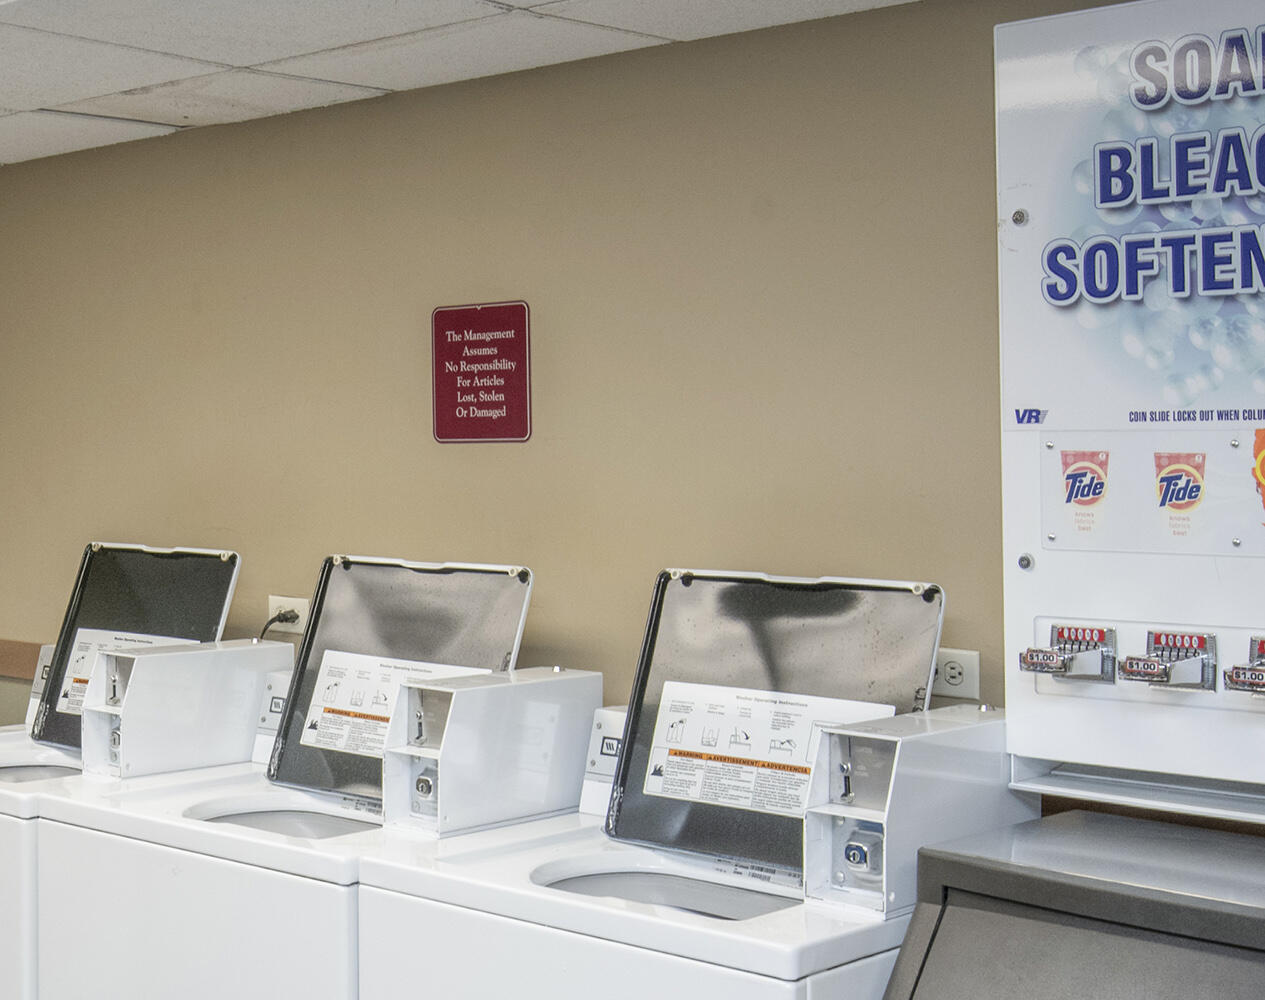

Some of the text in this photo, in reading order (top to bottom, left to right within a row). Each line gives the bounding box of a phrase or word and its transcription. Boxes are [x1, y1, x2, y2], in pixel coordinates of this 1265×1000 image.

[1133, 27, 1265, 107] SOA
[445, 329, 515, 342] The Management
[463, 346, 498, 356] Assumes
[445, 359, 516, 374] No Responsibility
[457, 375, 505, 387] For Articles
[457, 390, 505, 403] Lost, Stolen
[456, 405, 506, 419] Or Damaged
[1129, 411, 1147, 422] COIN
[1149, 411, 1170, 422] SLIDE
[1172, 410, 1197, 422] LOCKS
[1199, 410, 1214, 422] OUT
[1216, 409, 1240, 421] WHEN
[1065, 471, 1105, 503] Tide
[1159, 474, 1201, 507] Tide
[1028, 653, 1055, 662] $1.00
[1128, 661, 1156, 671] $1.00
[1234, 671, 1264, 681] $1.00
